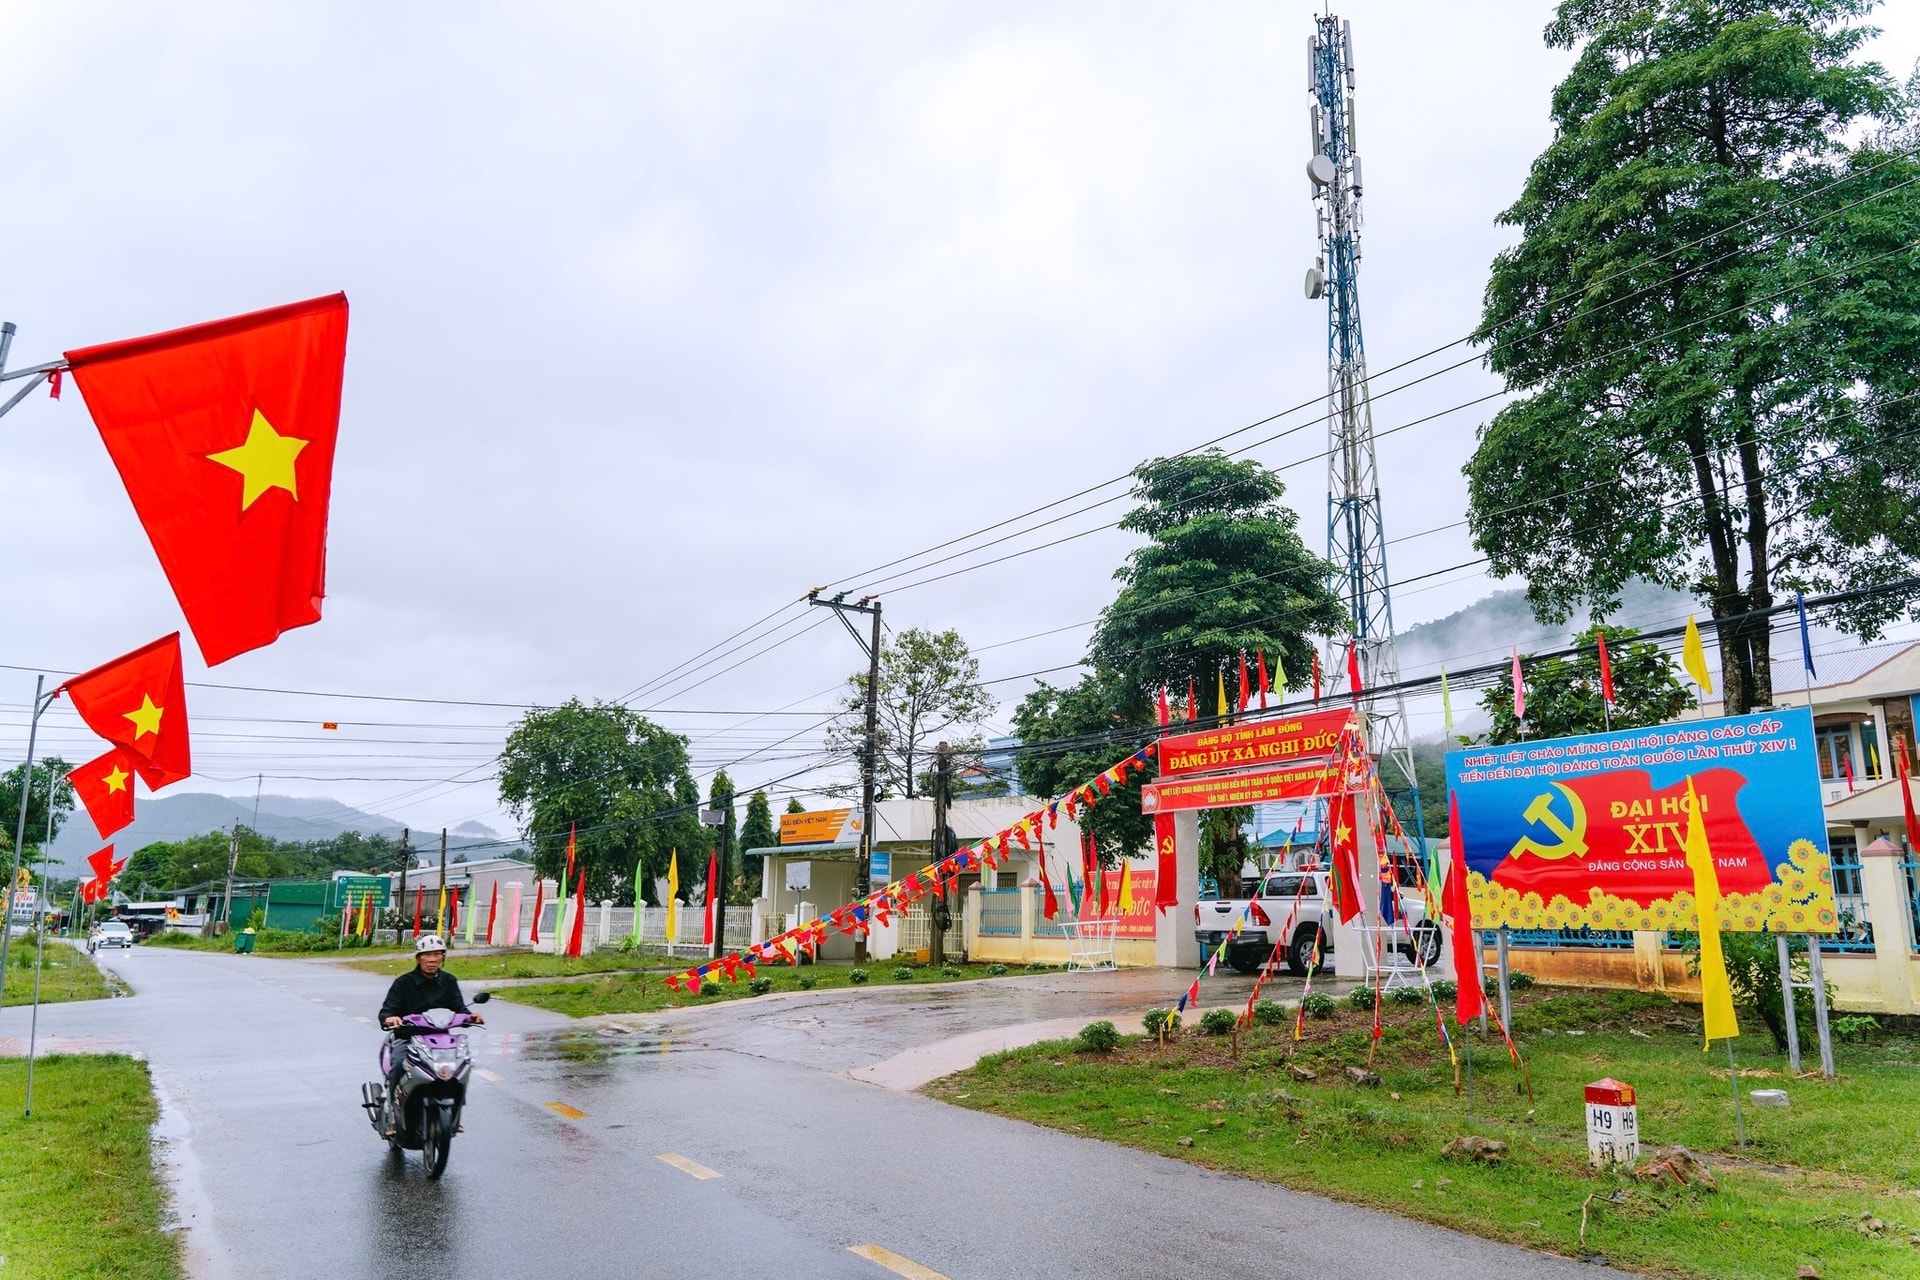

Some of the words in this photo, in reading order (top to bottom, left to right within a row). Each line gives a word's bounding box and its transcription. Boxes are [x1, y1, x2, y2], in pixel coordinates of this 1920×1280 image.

[1197, 735, 1219, 747] ĐẢNG
[1221, 733, 1233, 745] BỘ
[1256, 725, 1276, 739] LÂM
[1278, 720, 1303, 735] ĐỒNG
[1465, 754, 1498, 768] NHIỆT
[1501, 751, 1526, 765] LIỆT
[1528, 746, 1563, 761] CHÀO
[1567, 741, 1608, 757] MỪNG
[1611, 738, 1635, 753] ĐẠI
[1638, 734, 1663, 749] HỘI
[1666, 729, 1708, 745] ĐẢNG
[1712, 724, 1744, 739] CÁC
[1748, 719, 1782, 735] CẤP
[1169, 751, 1208, 770] ĐẢNG
[1210, 746, 1232, 764] ỦY
[1232, 742, 1256, 762] XÃ
[1258, 739, 1301, 759] NGHỊ
[1303, 728, 1339, 752] ĐỨC
[1460, 768, 1485, 783] TIẾN
[1487, 765, 1511, 781] ĐẾN
[1514, 763, 1535, 779] ĐẠI
[1537, 761, 1560, 776] HỘI
[1562, 758, 1599, 773] ĐẢNG
[1603, 753, 1639, 768] TOÀN
[1642, 749, 1685, 765] QUỐC
[1688, 744, 1720, 760] LẦN
[1722, 739, 1756, 757] THỨ
[1760, 739, 1788, 753] XIV
[1789, 737, 1796, 750] !
[815, 816, 828, 824] NAM
[1610, 798, 1653, 822] ĐẠI
[1588, 859, 1620, 872] ĐẢNG
[1623, 858, 1657, 873] CỘNG
[1659, 856, 1685, 870] SẢN
[1718, 857, 1748, 868] NAM
[1592, 1109, 1612, 1129] H9
[1622, 1111, 1634, 1130] H9
